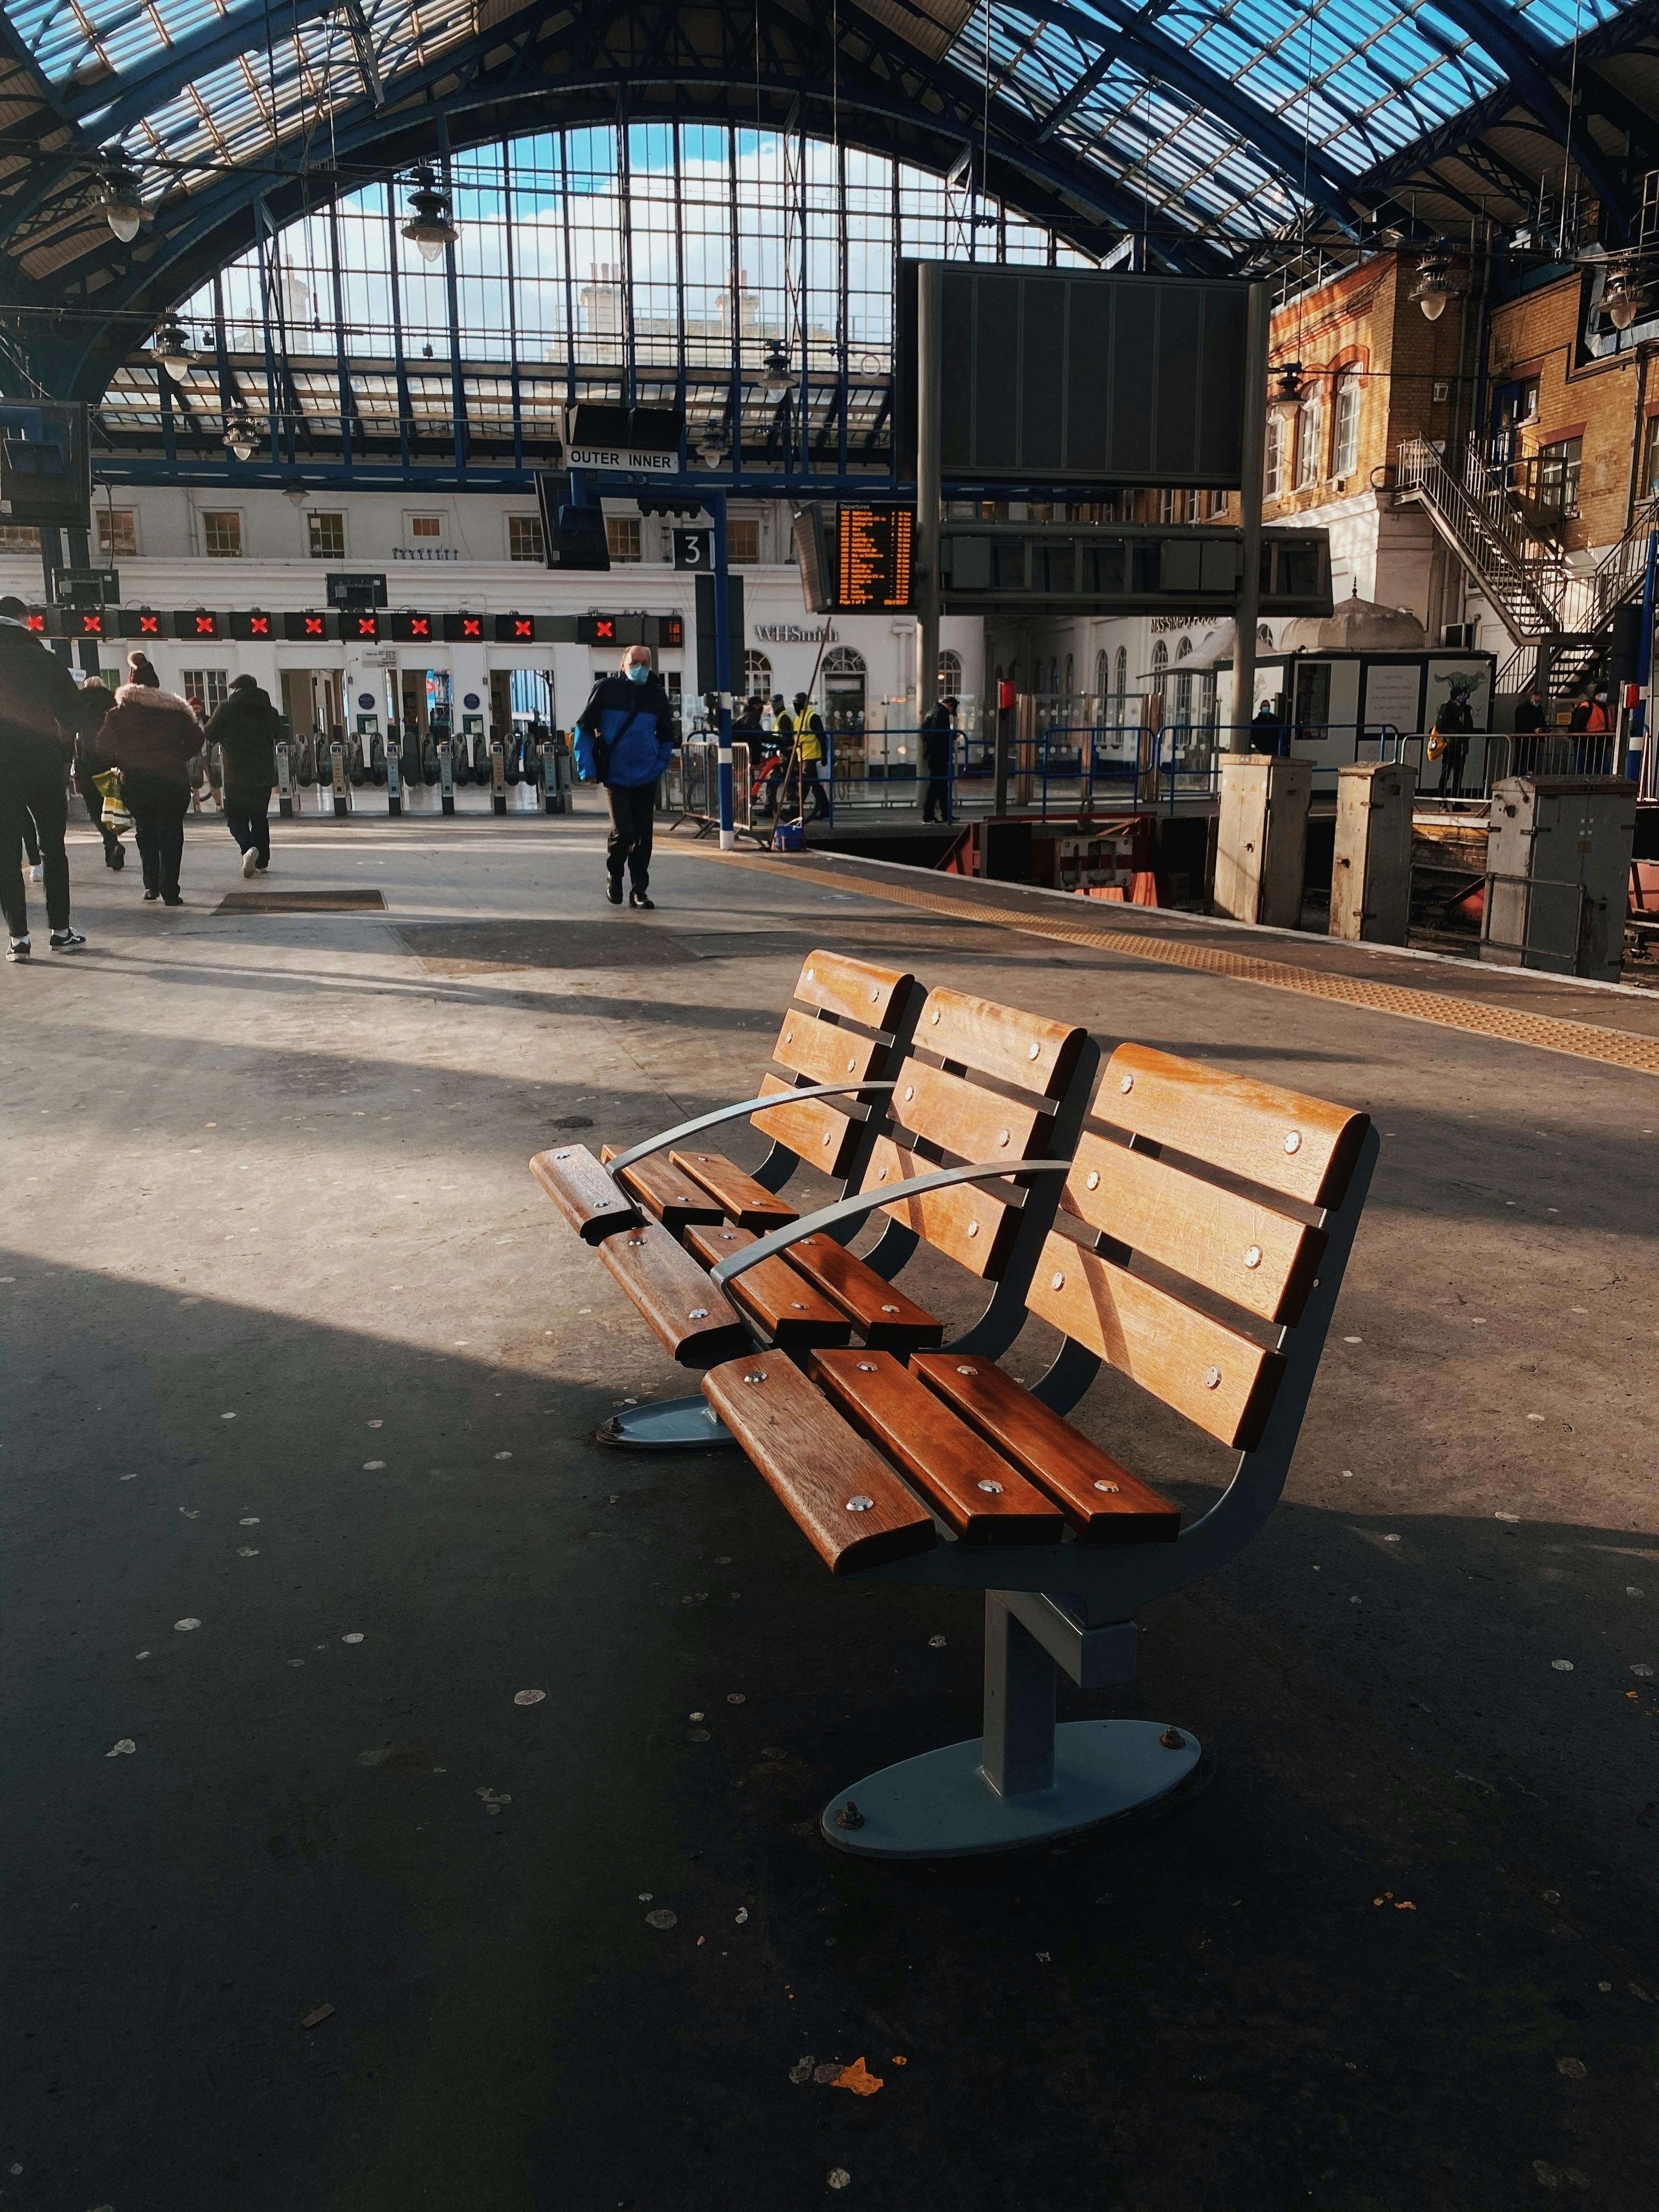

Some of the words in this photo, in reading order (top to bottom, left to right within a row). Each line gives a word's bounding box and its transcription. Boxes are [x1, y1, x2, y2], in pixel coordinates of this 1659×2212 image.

[571, 450, 619, 465] OUTER
[629, 454, 672, 468] INNER
[685, 536, 701, 563] 3
